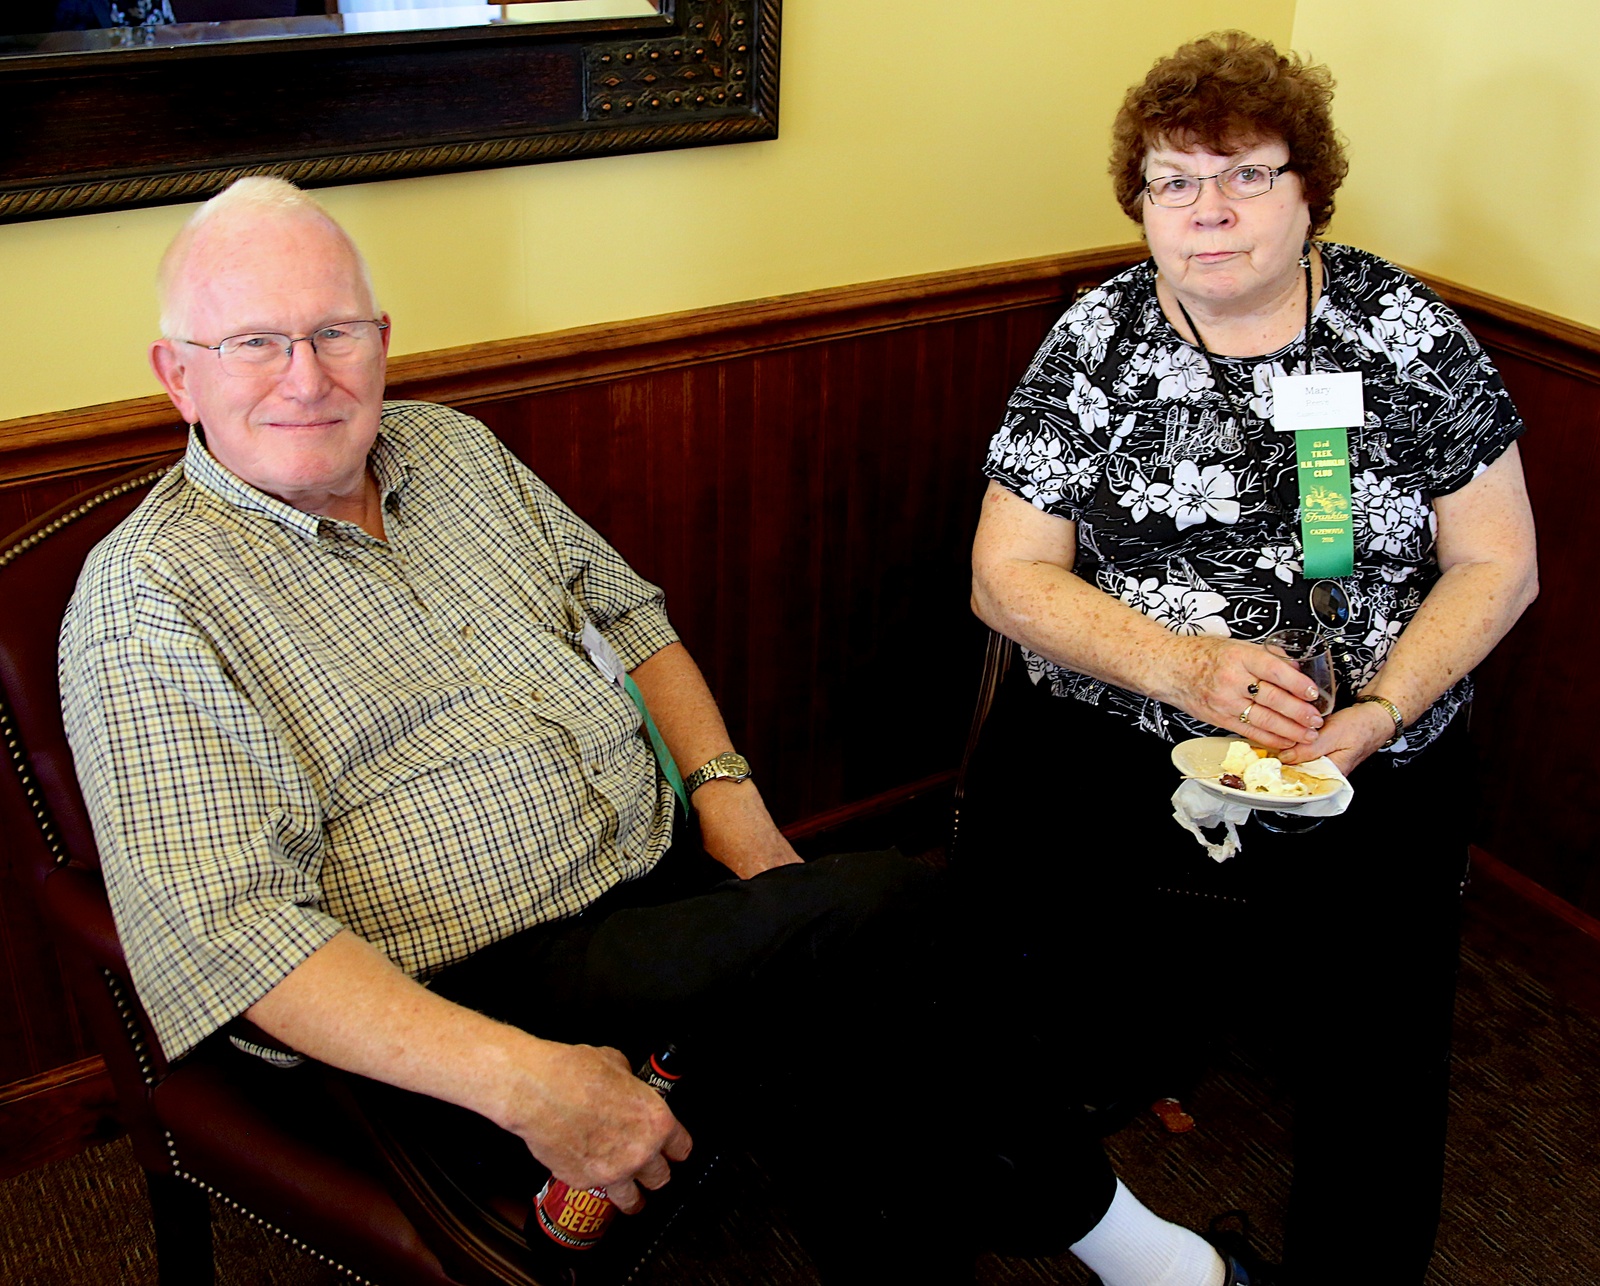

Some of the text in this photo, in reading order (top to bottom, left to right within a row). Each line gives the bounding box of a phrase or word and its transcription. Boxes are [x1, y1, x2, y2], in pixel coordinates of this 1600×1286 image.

[1304, 386, 1332, 396] Mary
[1311, 450, 1333, 458] TREK
[1304, 511, 1350, 523] Franklin
[563, 1187, 611, 1217] ROOT
[557, 1204, 605, 1233] BEER
